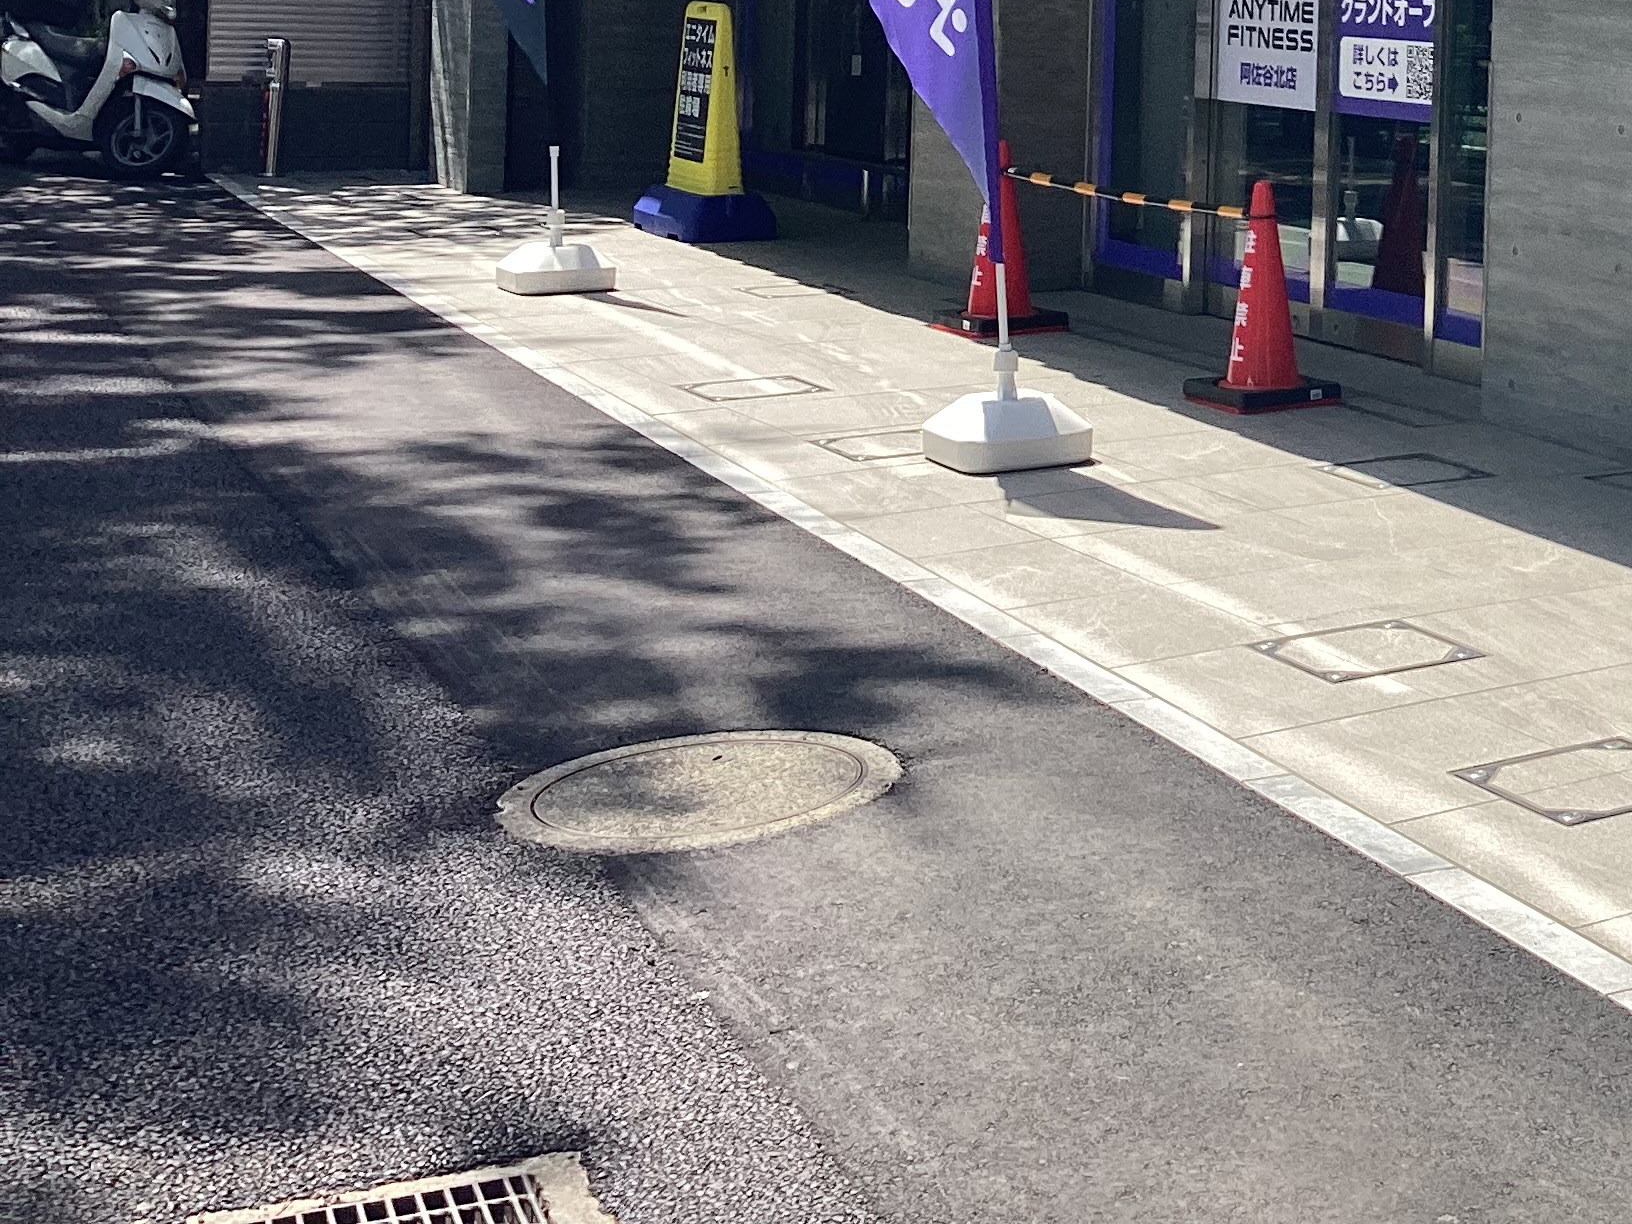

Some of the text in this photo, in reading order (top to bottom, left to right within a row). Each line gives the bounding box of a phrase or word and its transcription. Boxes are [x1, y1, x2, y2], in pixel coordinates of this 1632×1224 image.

[1228, 25, 1314, 52] FITNESS
[1353, 44, 1399, 66] 詳しくは
[1240, 62, 1297, 90] 阿佐谷北店
[1353, 71, 1386, 92] こちら
